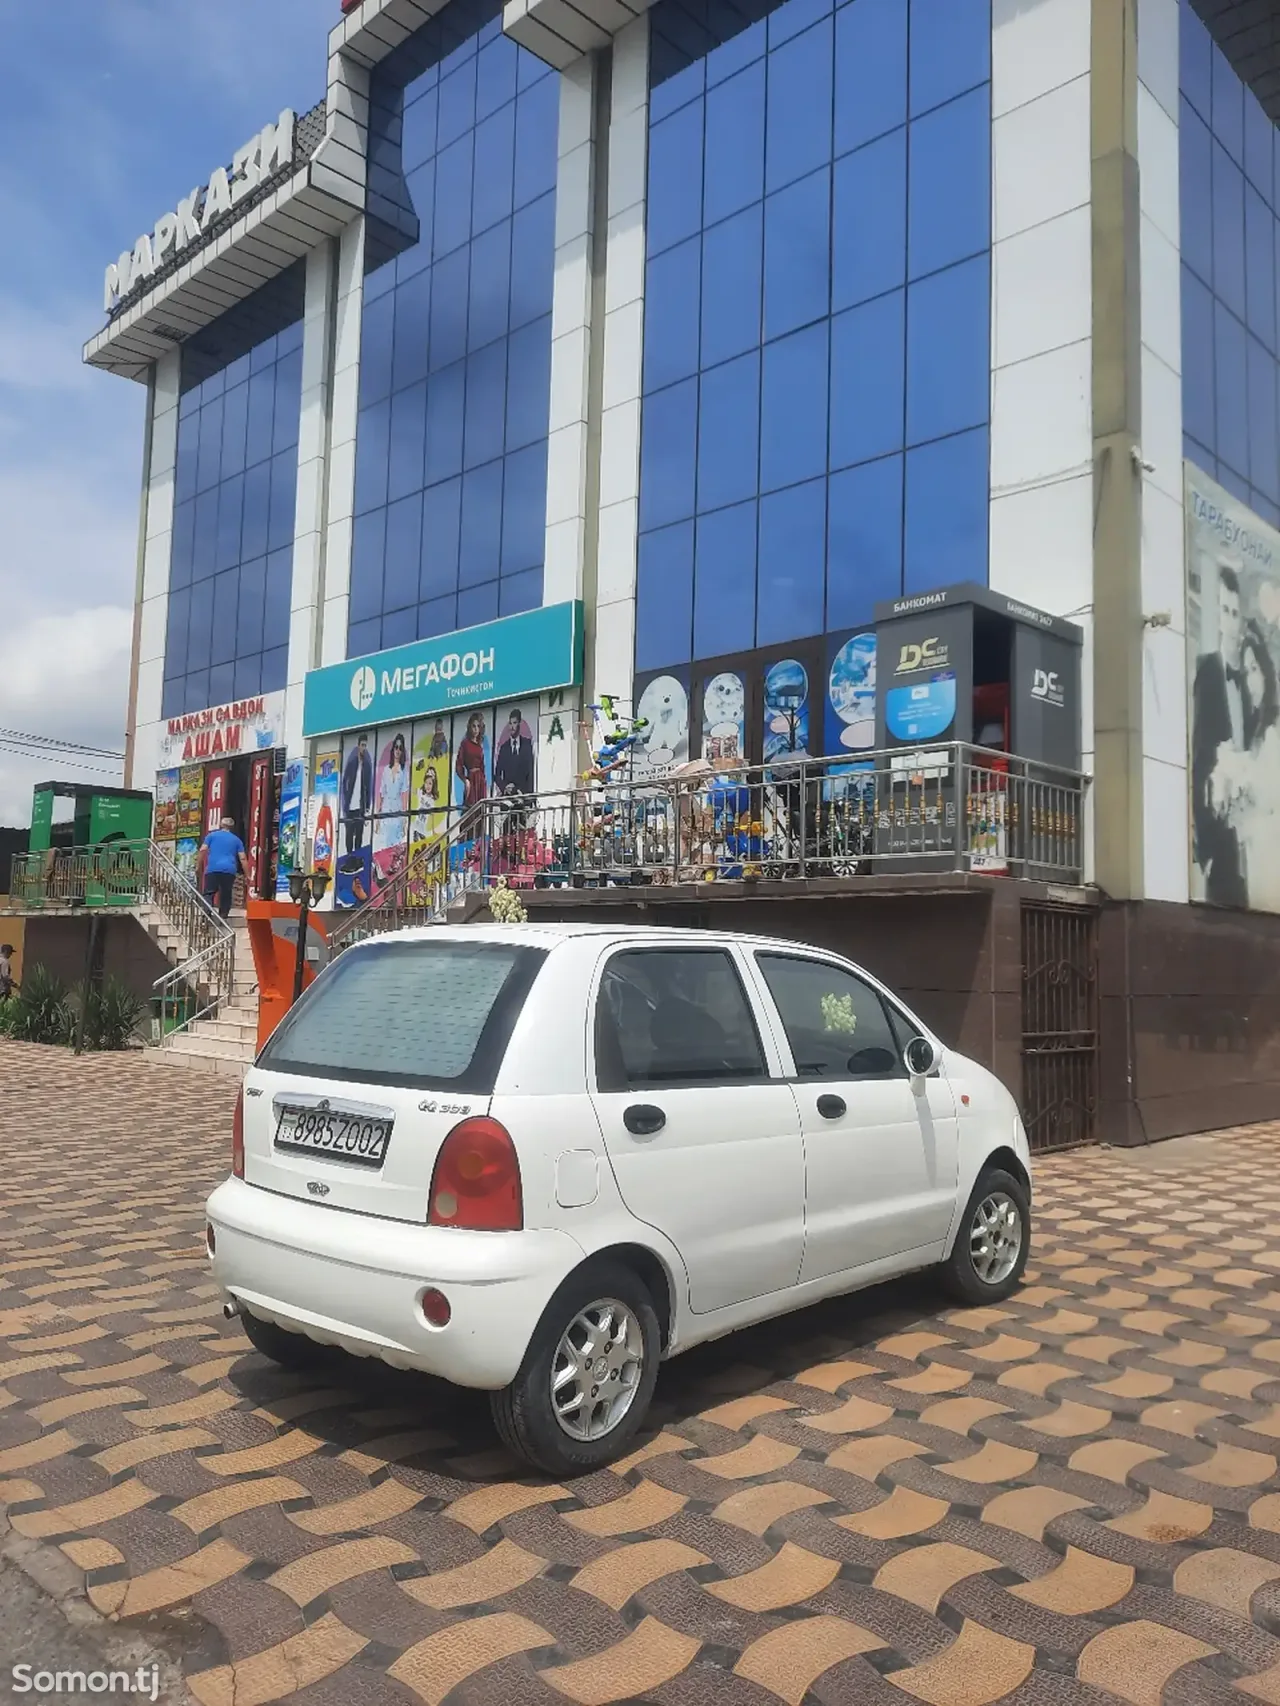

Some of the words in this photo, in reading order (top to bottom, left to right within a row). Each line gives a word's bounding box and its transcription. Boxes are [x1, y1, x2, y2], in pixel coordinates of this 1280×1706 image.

[103, 107, 296, 314] МАРКАЗИ
[894, 591, 947, 613] БАНКОМАТ
[380, 647, 495, 696] МЕГАФОН
[294, 1112, 386, 1158] 8985Z002
